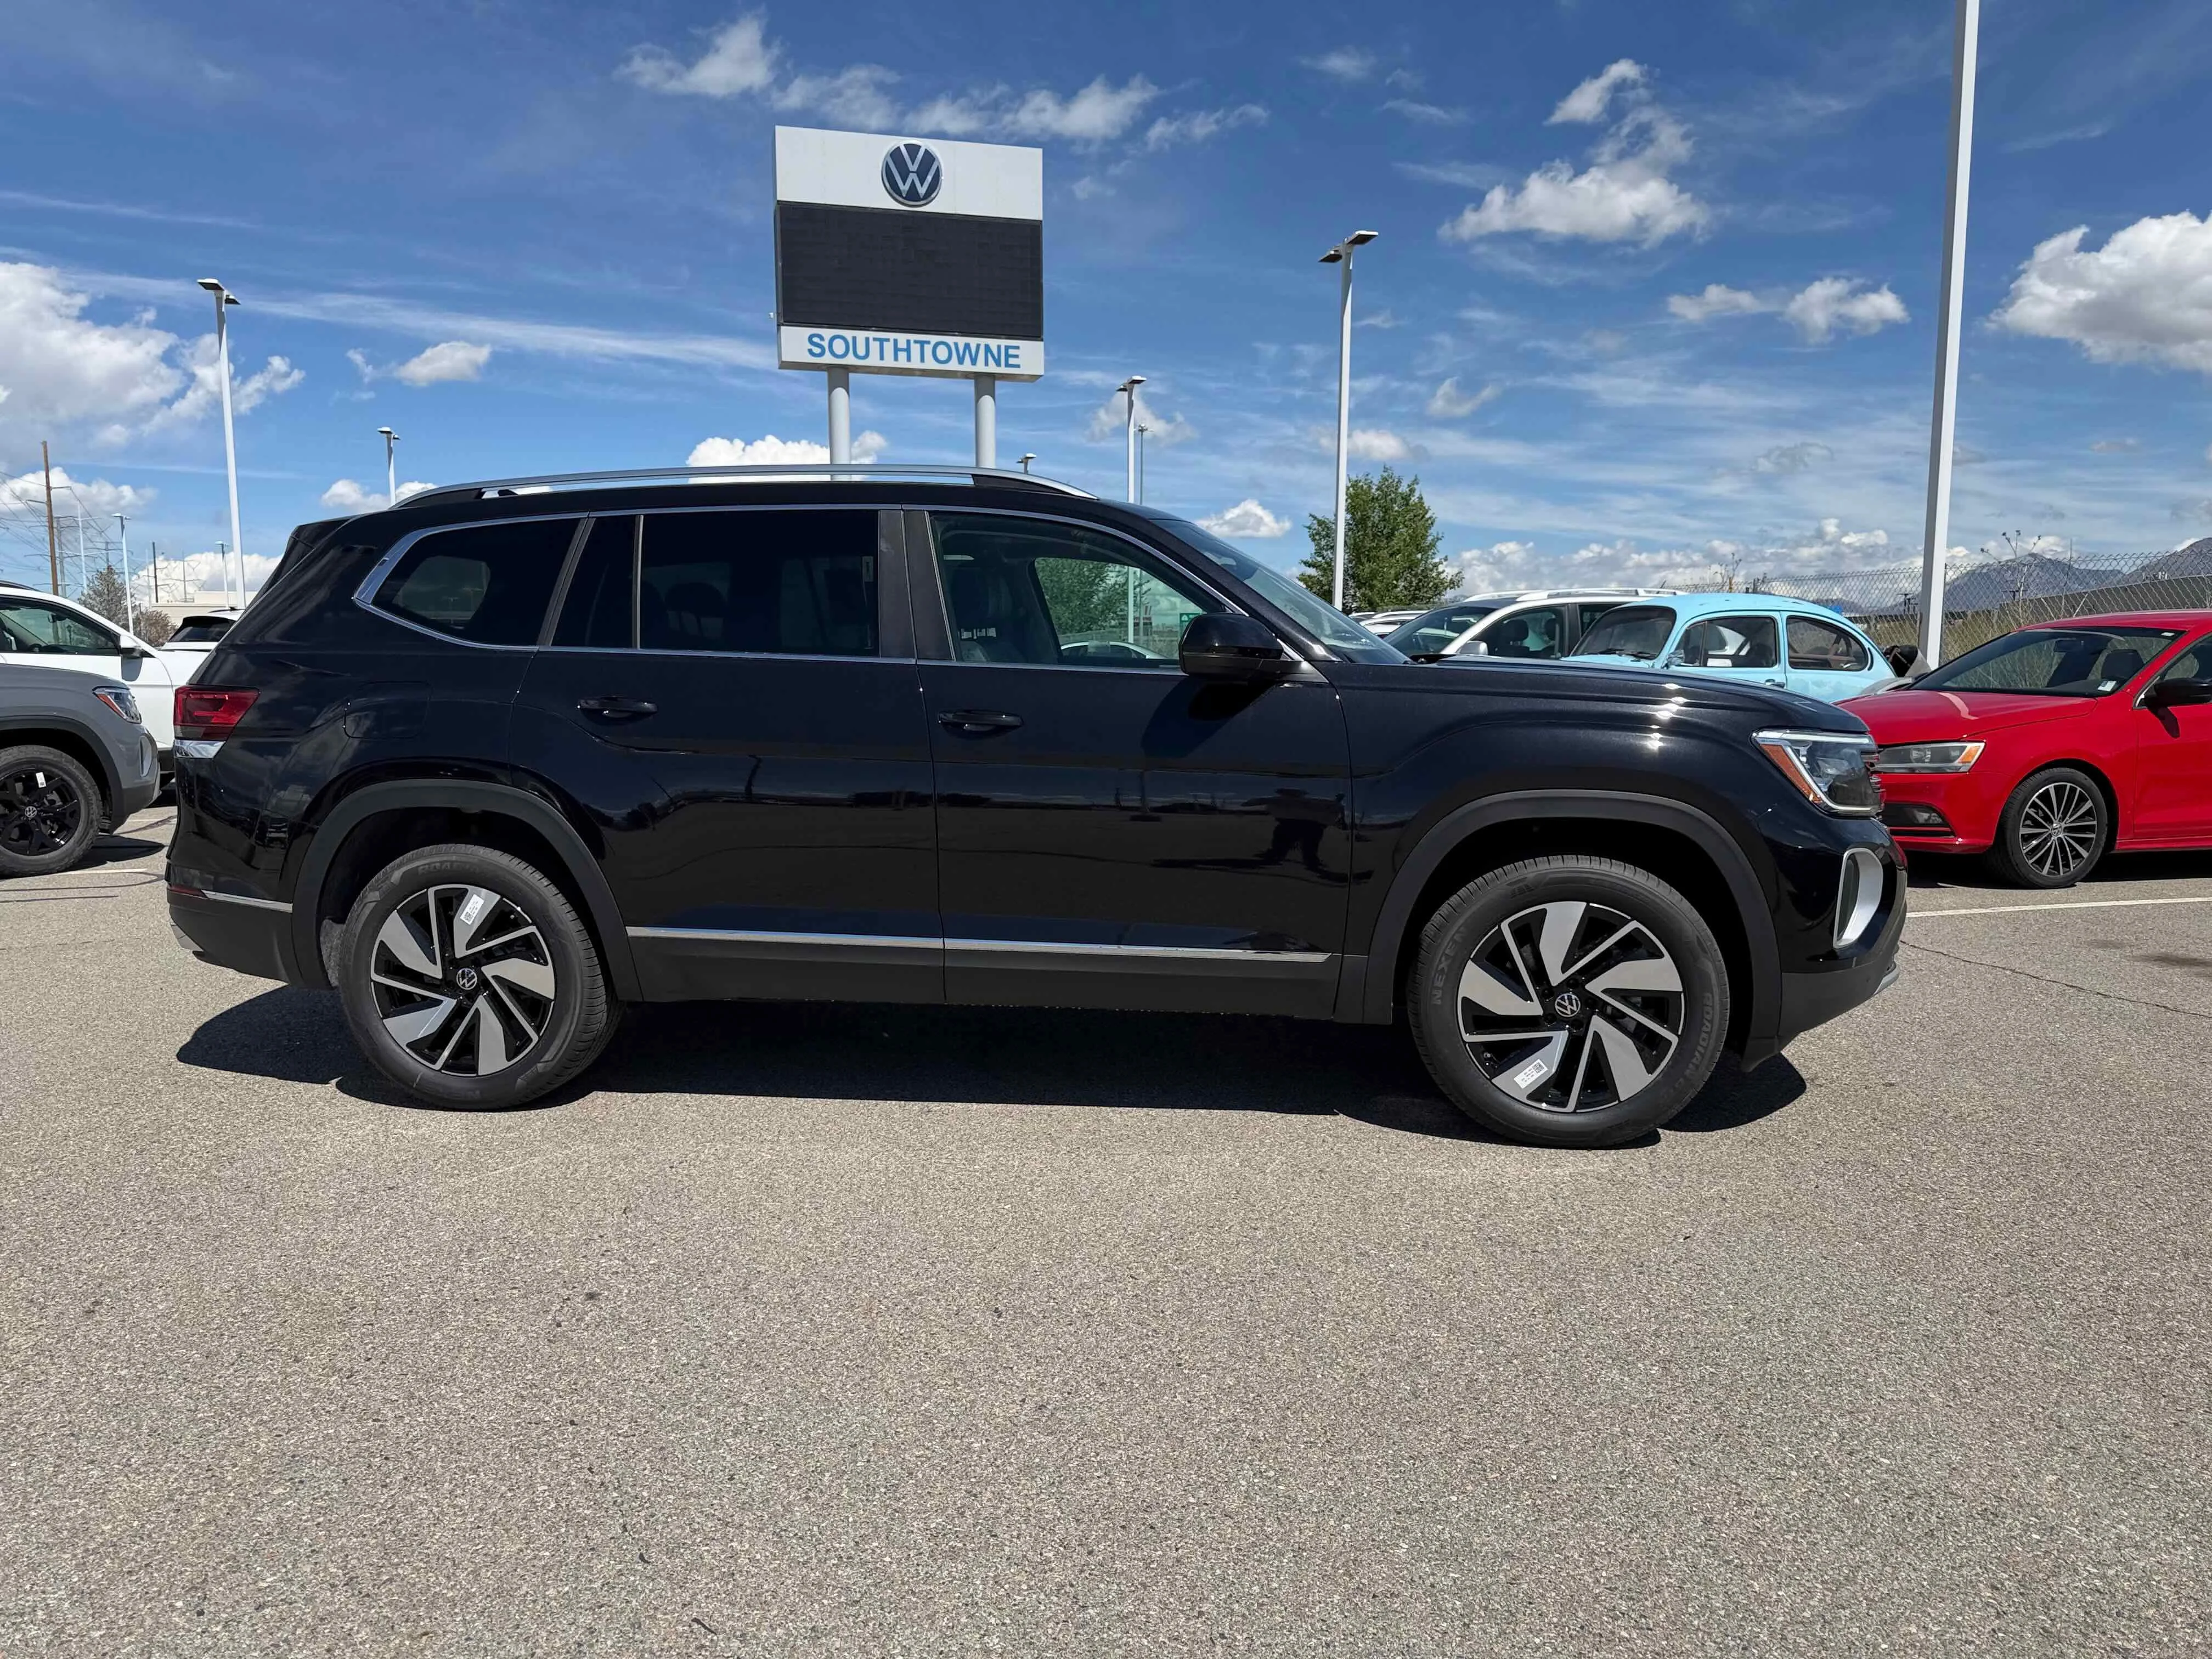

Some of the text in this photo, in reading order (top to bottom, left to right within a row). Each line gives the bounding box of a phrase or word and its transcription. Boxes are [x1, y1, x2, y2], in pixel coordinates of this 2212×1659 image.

[884, 143, 940, 199] VW
[808, 333, 1021, 369] SOUTHTOWNE
[1431, 927, 1467, 1005] NEXEN
